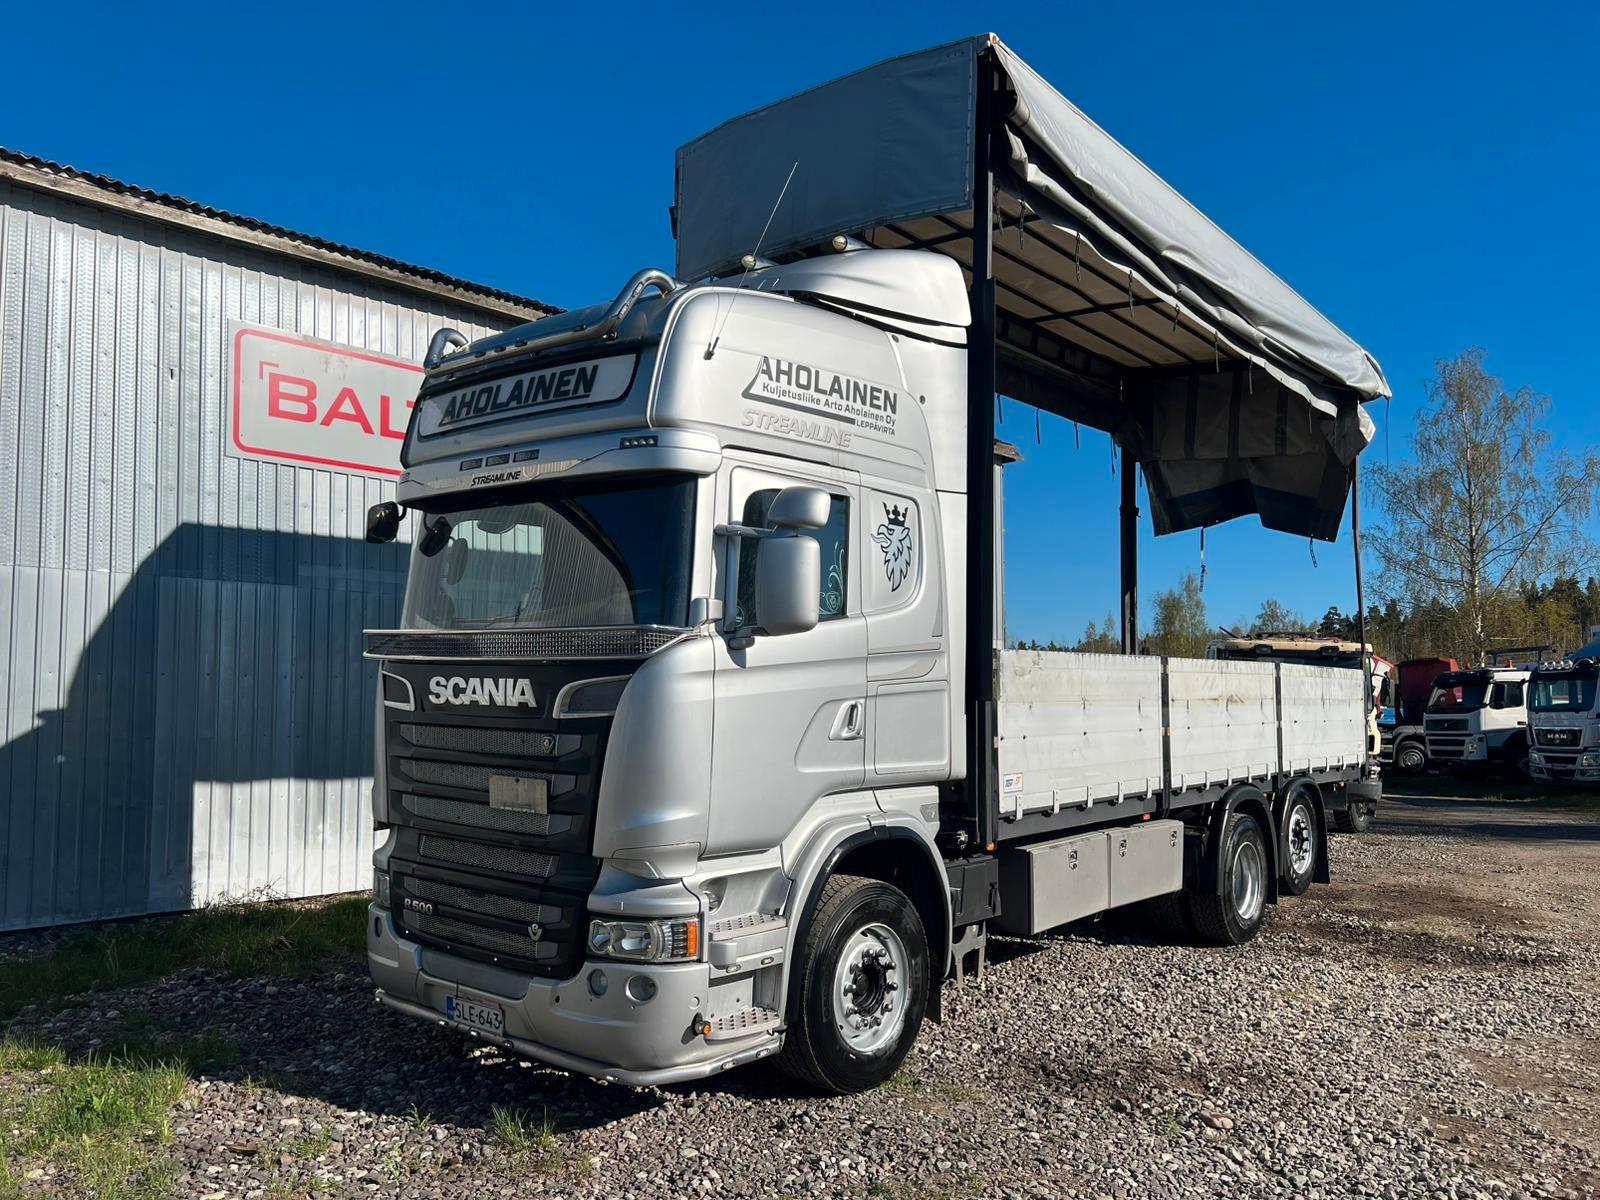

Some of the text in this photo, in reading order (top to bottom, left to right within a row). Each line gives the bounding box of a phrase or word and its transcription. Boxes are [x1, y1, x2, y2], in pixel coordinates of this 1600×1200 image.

[268, 371, 414, 441] BAL
[442, 364, 599, 421] AHOLAINEN
[758, 355, 898, 415] AHOLAINEN
[762, 381, 897, 428] Kuljetusliike Arto Aholainen Oy
[741, 408, 852, 448] STREAMLINE
[471, 470, 522, 487] STREAMLINE
[428, 676, 538, 708] SCANIA
